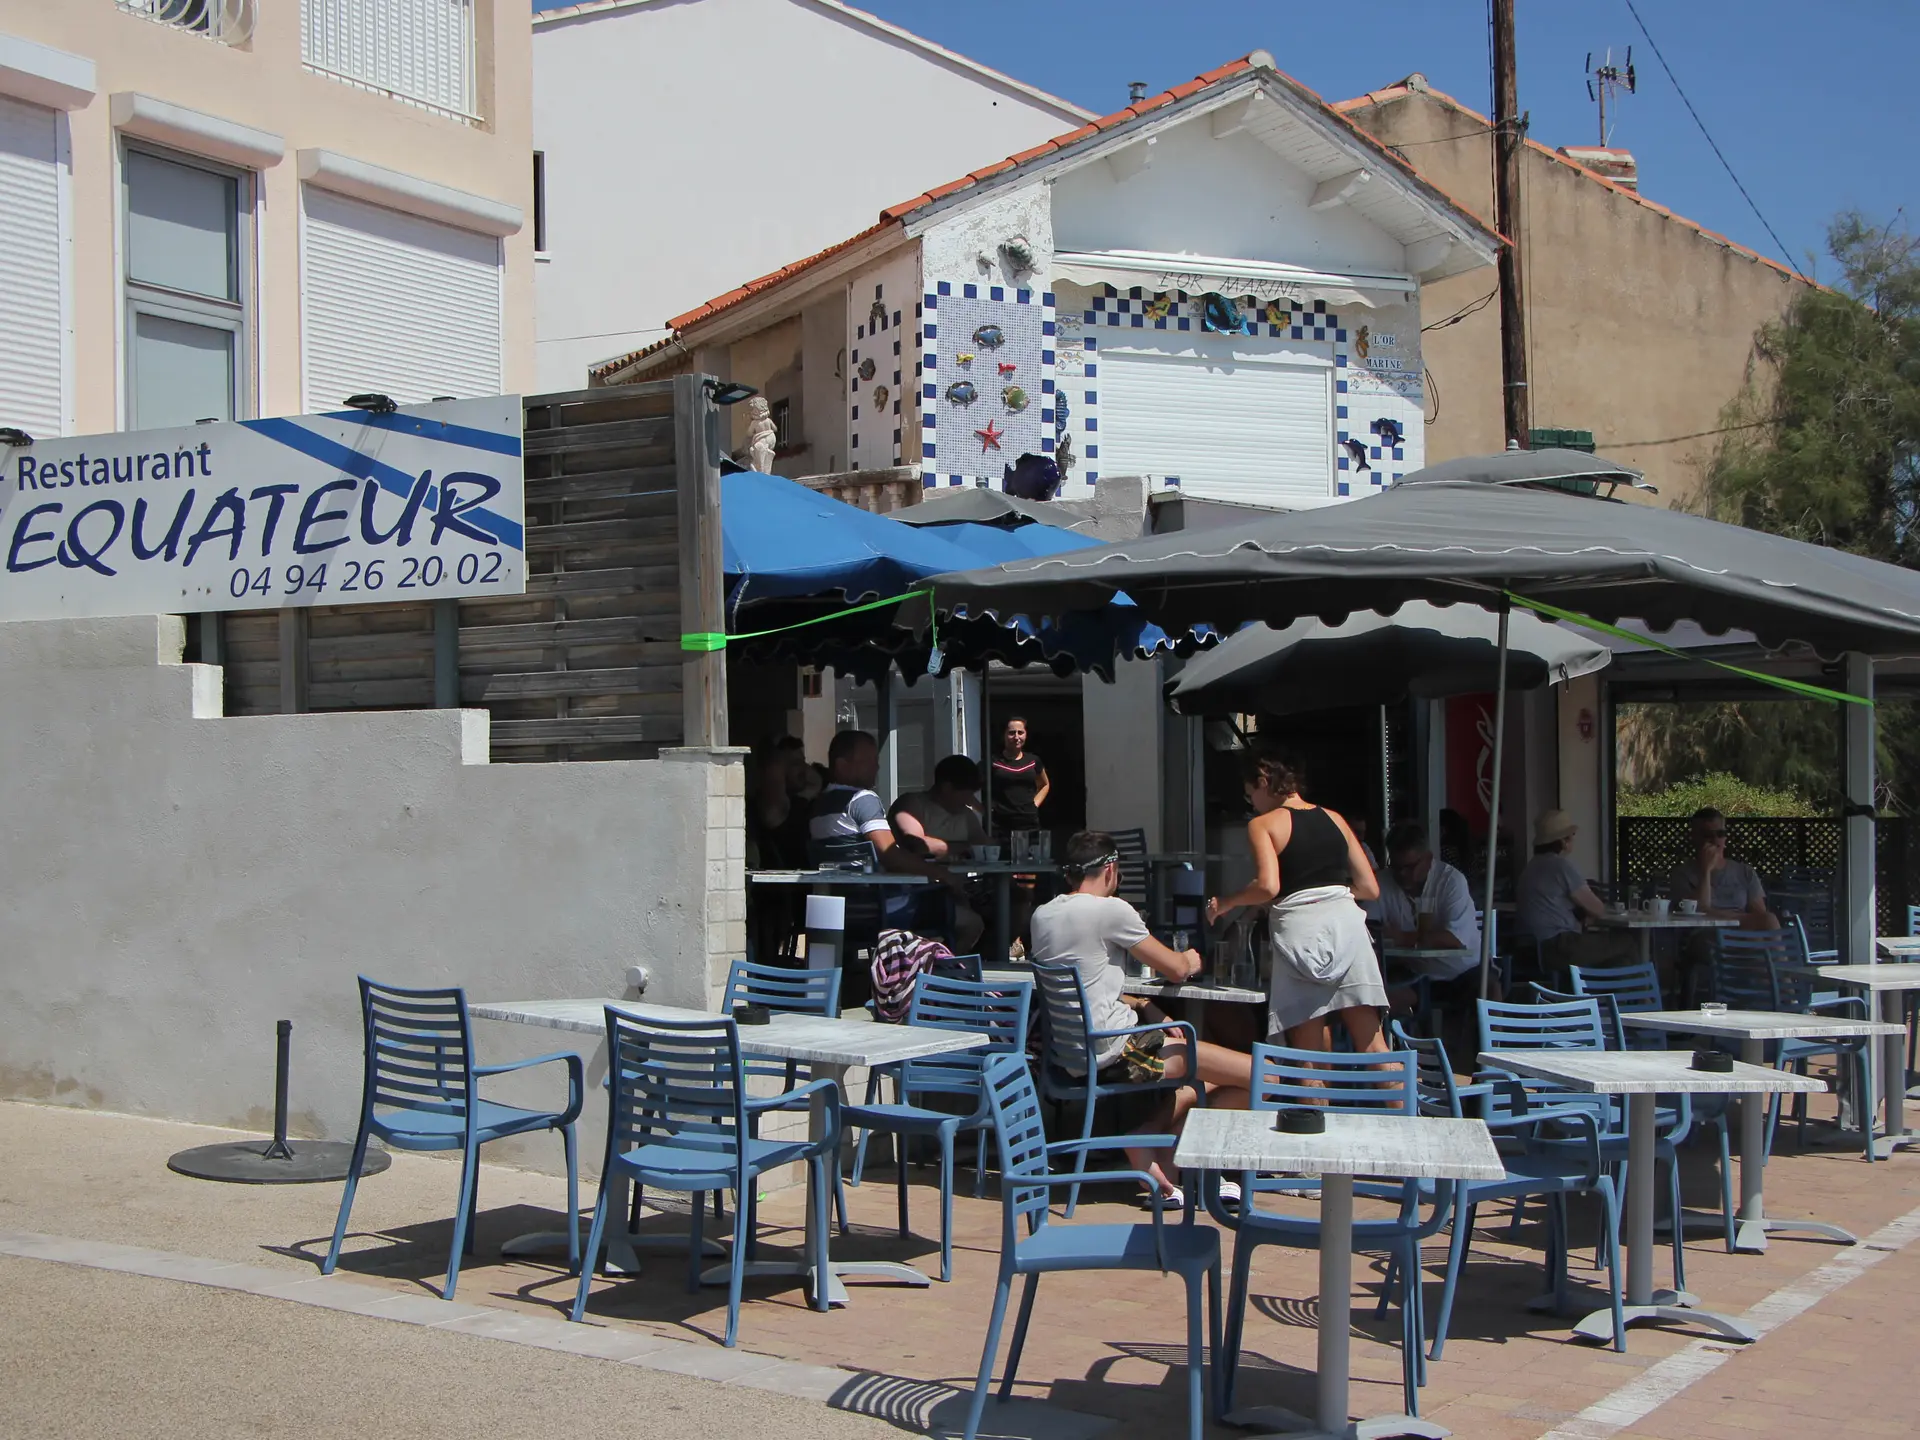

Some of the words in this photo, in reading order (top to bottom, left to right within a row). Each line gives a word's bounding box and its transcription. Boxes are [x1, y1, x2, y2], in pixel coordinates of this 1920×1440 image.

[1219, 276, 1301, 298] MARINE
[1373, 335, 1395, 346] L'OR
[1365, 358, 1402, 369] MARINE
[18, 448, 212, 491] Restaurant
[8, 469, 502, 577] EQUATEUR
[229, 566, 272, 598] 04
[283, 563, 328, 595] 94
[340, 559, 386, 591] 26
[397, 555, 443, 588] 20
[456, 551, 503, 585] 02
